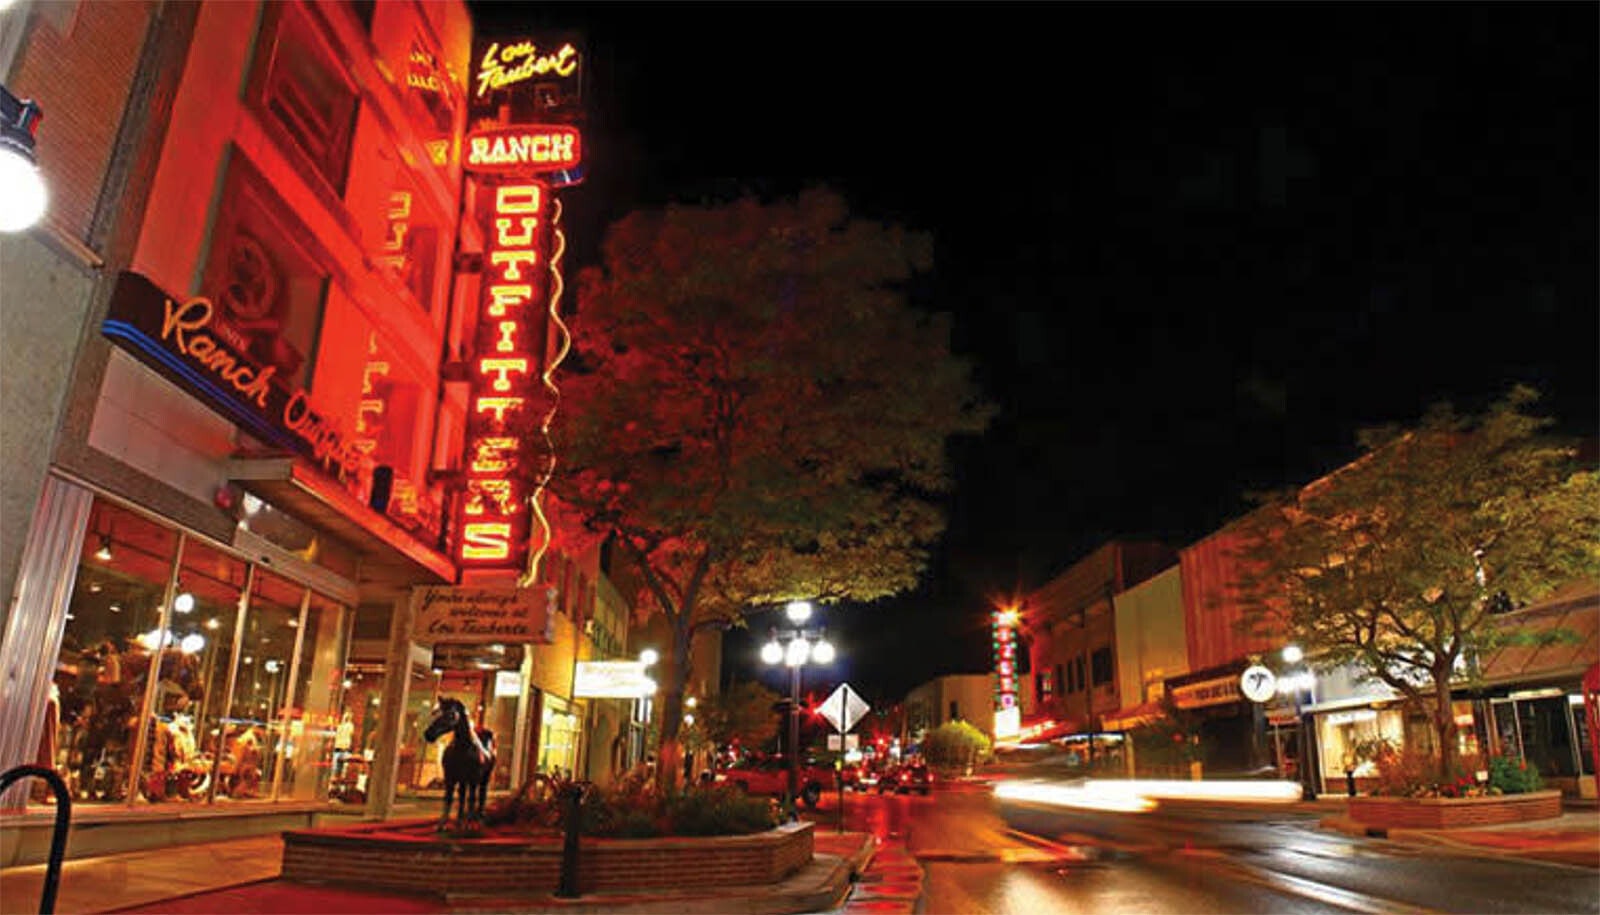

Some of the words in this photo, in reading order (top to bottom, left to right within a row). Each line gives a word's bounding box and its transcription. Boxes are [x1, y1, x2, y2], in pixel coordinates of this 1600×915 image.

[477, 43, 577, 97] Taubert
[481, 42, 536, 69] Lou
[468, 133, 574, 164] RANCH
[161, 297, 276, 407] Ranch
[462, 185, 540, 558] OUTFITTERS
